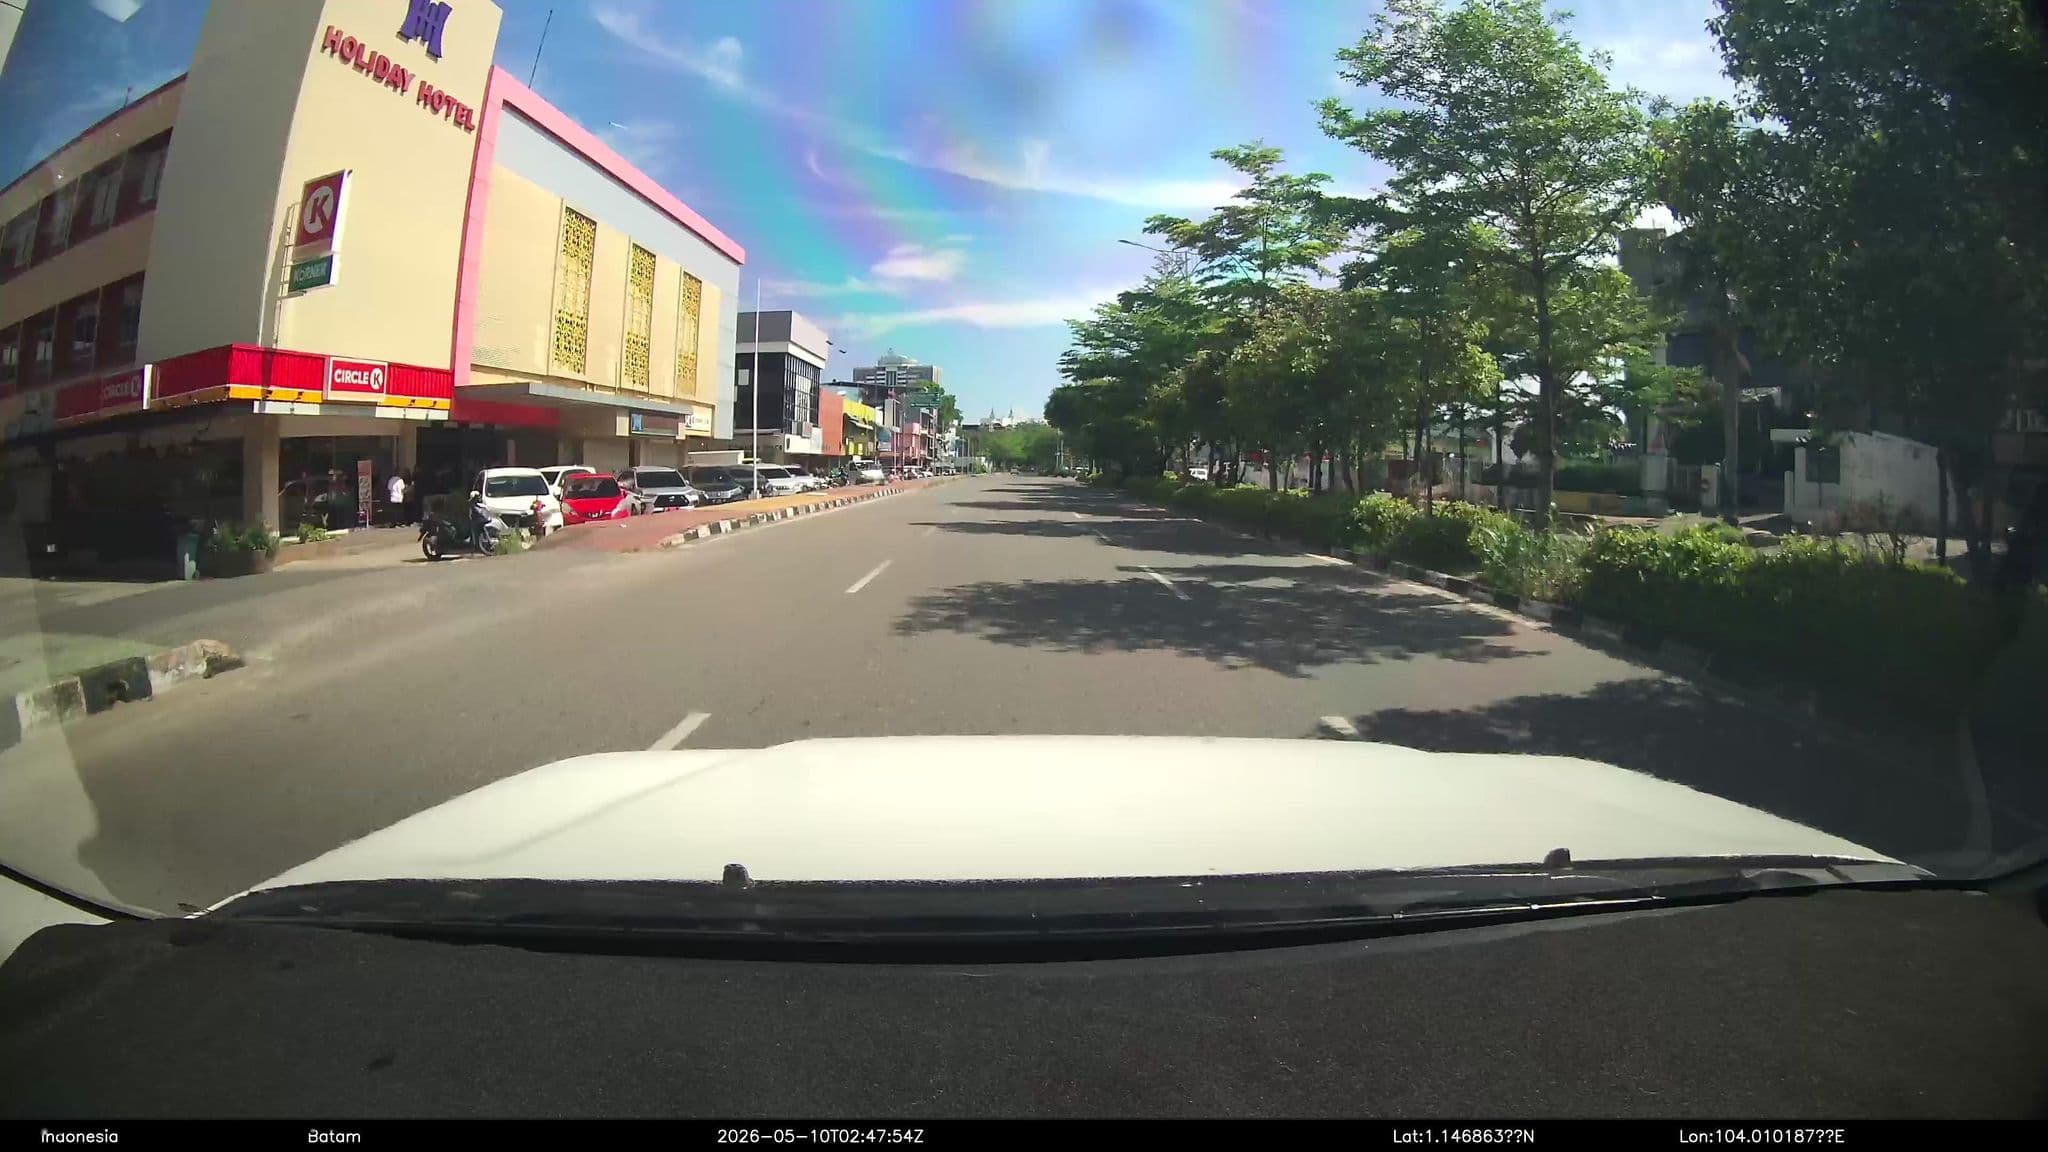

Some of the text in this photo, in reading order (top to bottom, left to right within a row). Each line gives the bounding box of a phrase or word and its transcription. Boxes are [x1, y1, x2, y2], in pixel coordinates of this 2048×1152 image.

[320, 25, 475, 134] HOLIDAY HOTEL
[307, 190, 332, 230] K
[333, 367, 370, 386] CIRCLE
